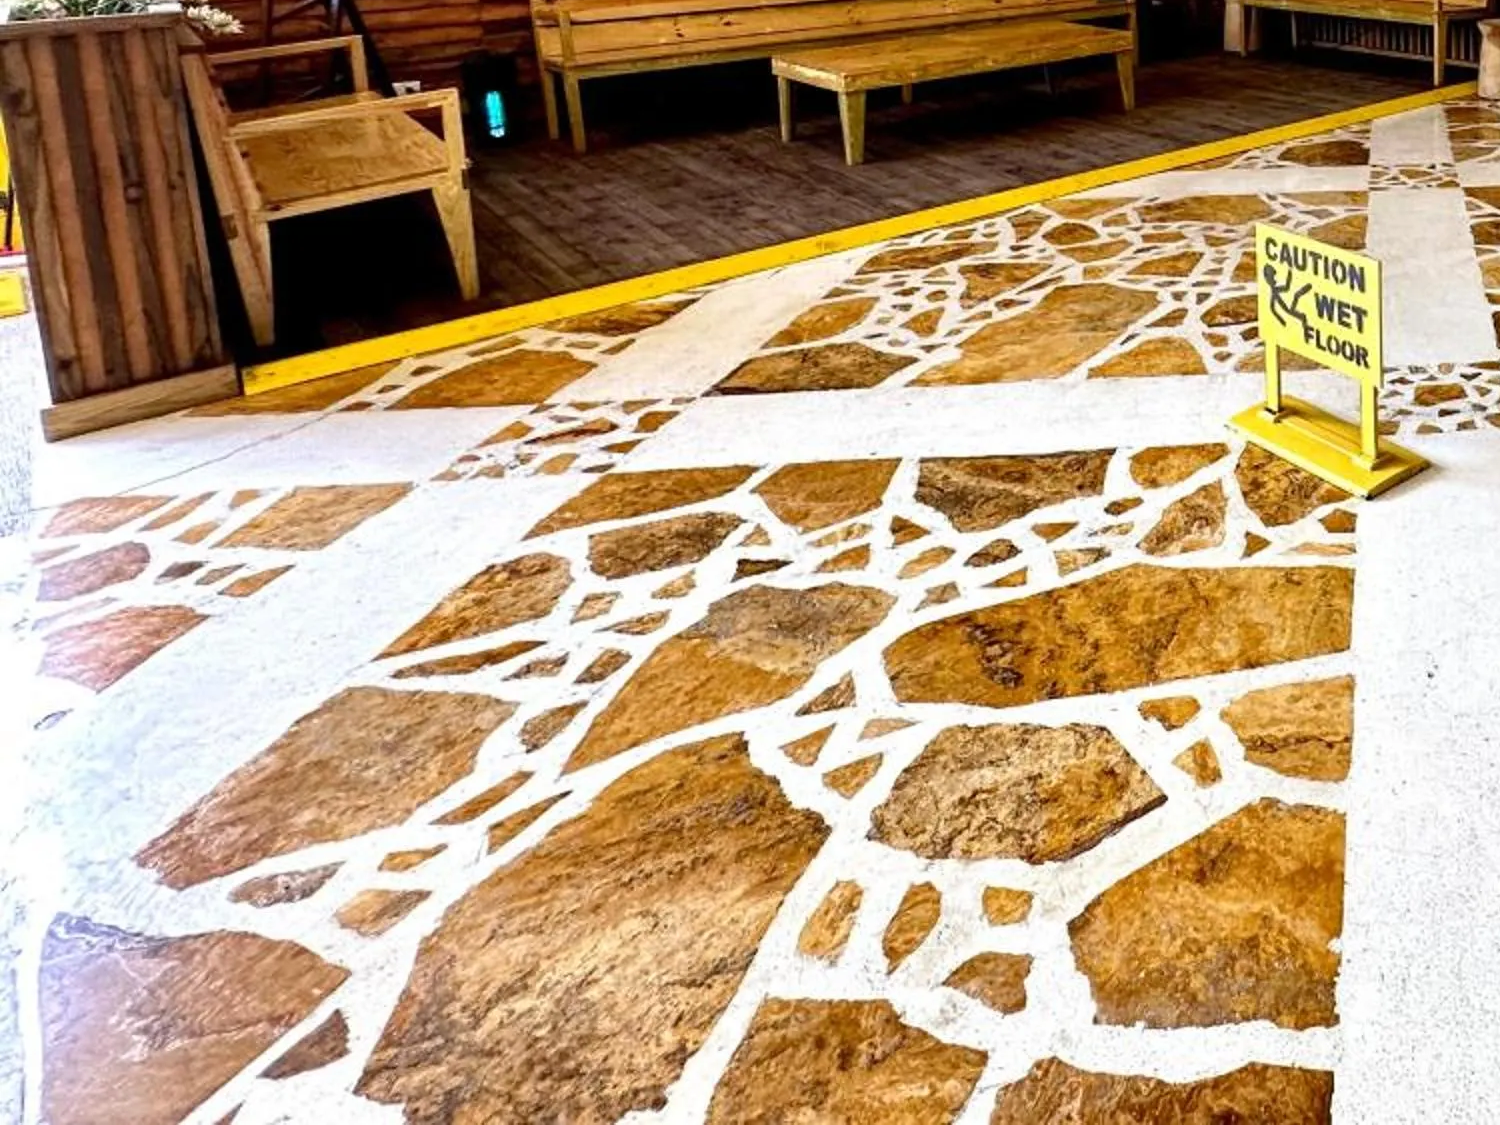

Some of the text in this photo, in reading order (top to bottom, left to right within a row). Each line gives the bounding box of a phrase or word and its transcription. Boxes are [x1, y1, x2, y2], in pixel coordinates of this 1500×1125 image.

[1265, 237, 1365, 293] CAUTION
[1315, 292, 1367, 333] WET
[1303, 324, 1370, 369] FLOOR
